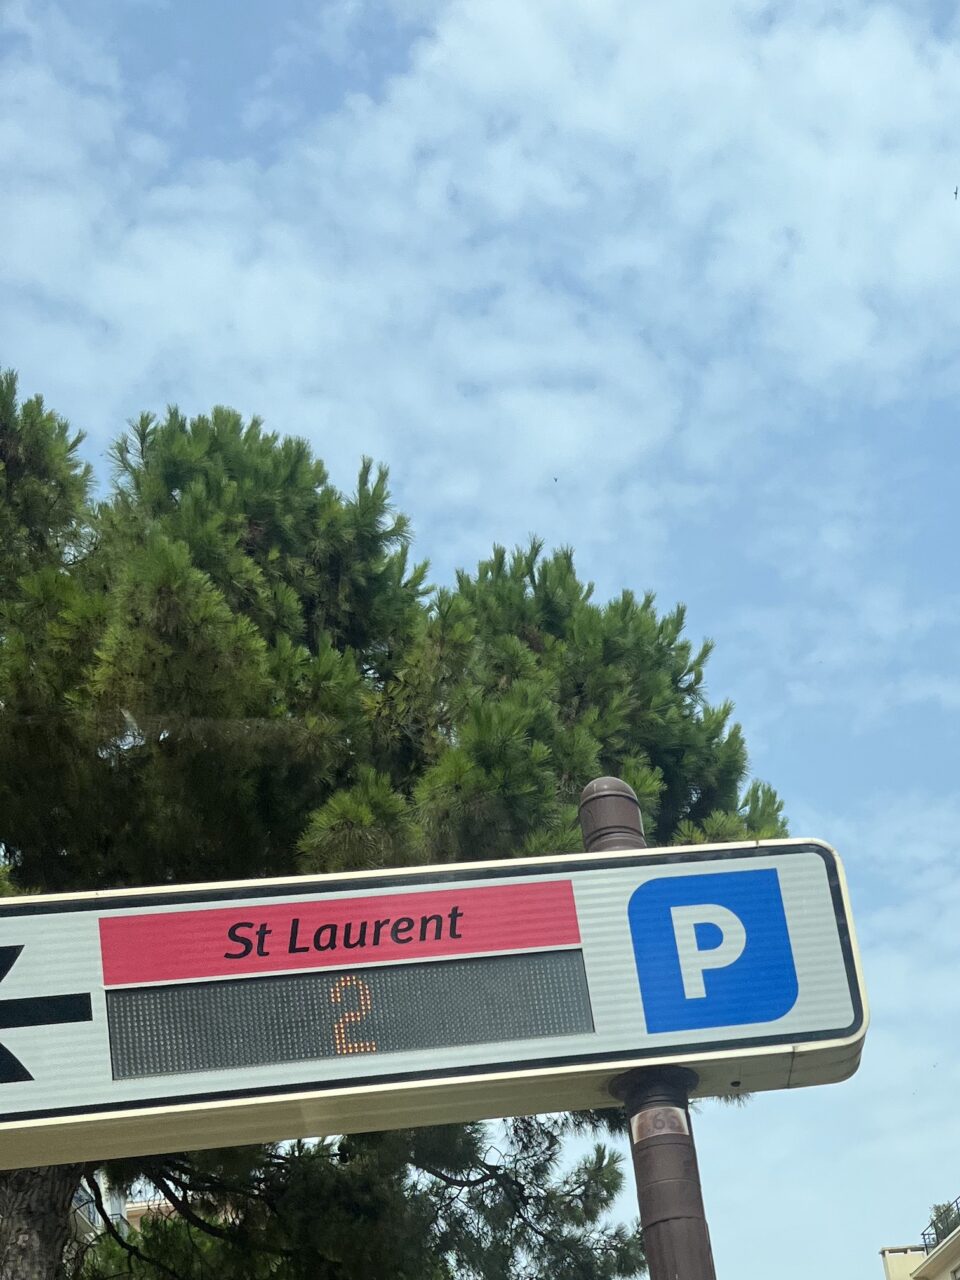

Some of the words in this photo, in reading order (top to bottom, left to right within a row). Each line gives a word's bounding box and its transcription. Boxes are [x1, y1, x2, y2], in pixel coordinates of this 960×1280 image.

[224, 921, 272, 960] St
[288, 905, 464, 954] Laurent
[670, 903, 747, 1000] P
[329, 974, 377, 1055] 2
